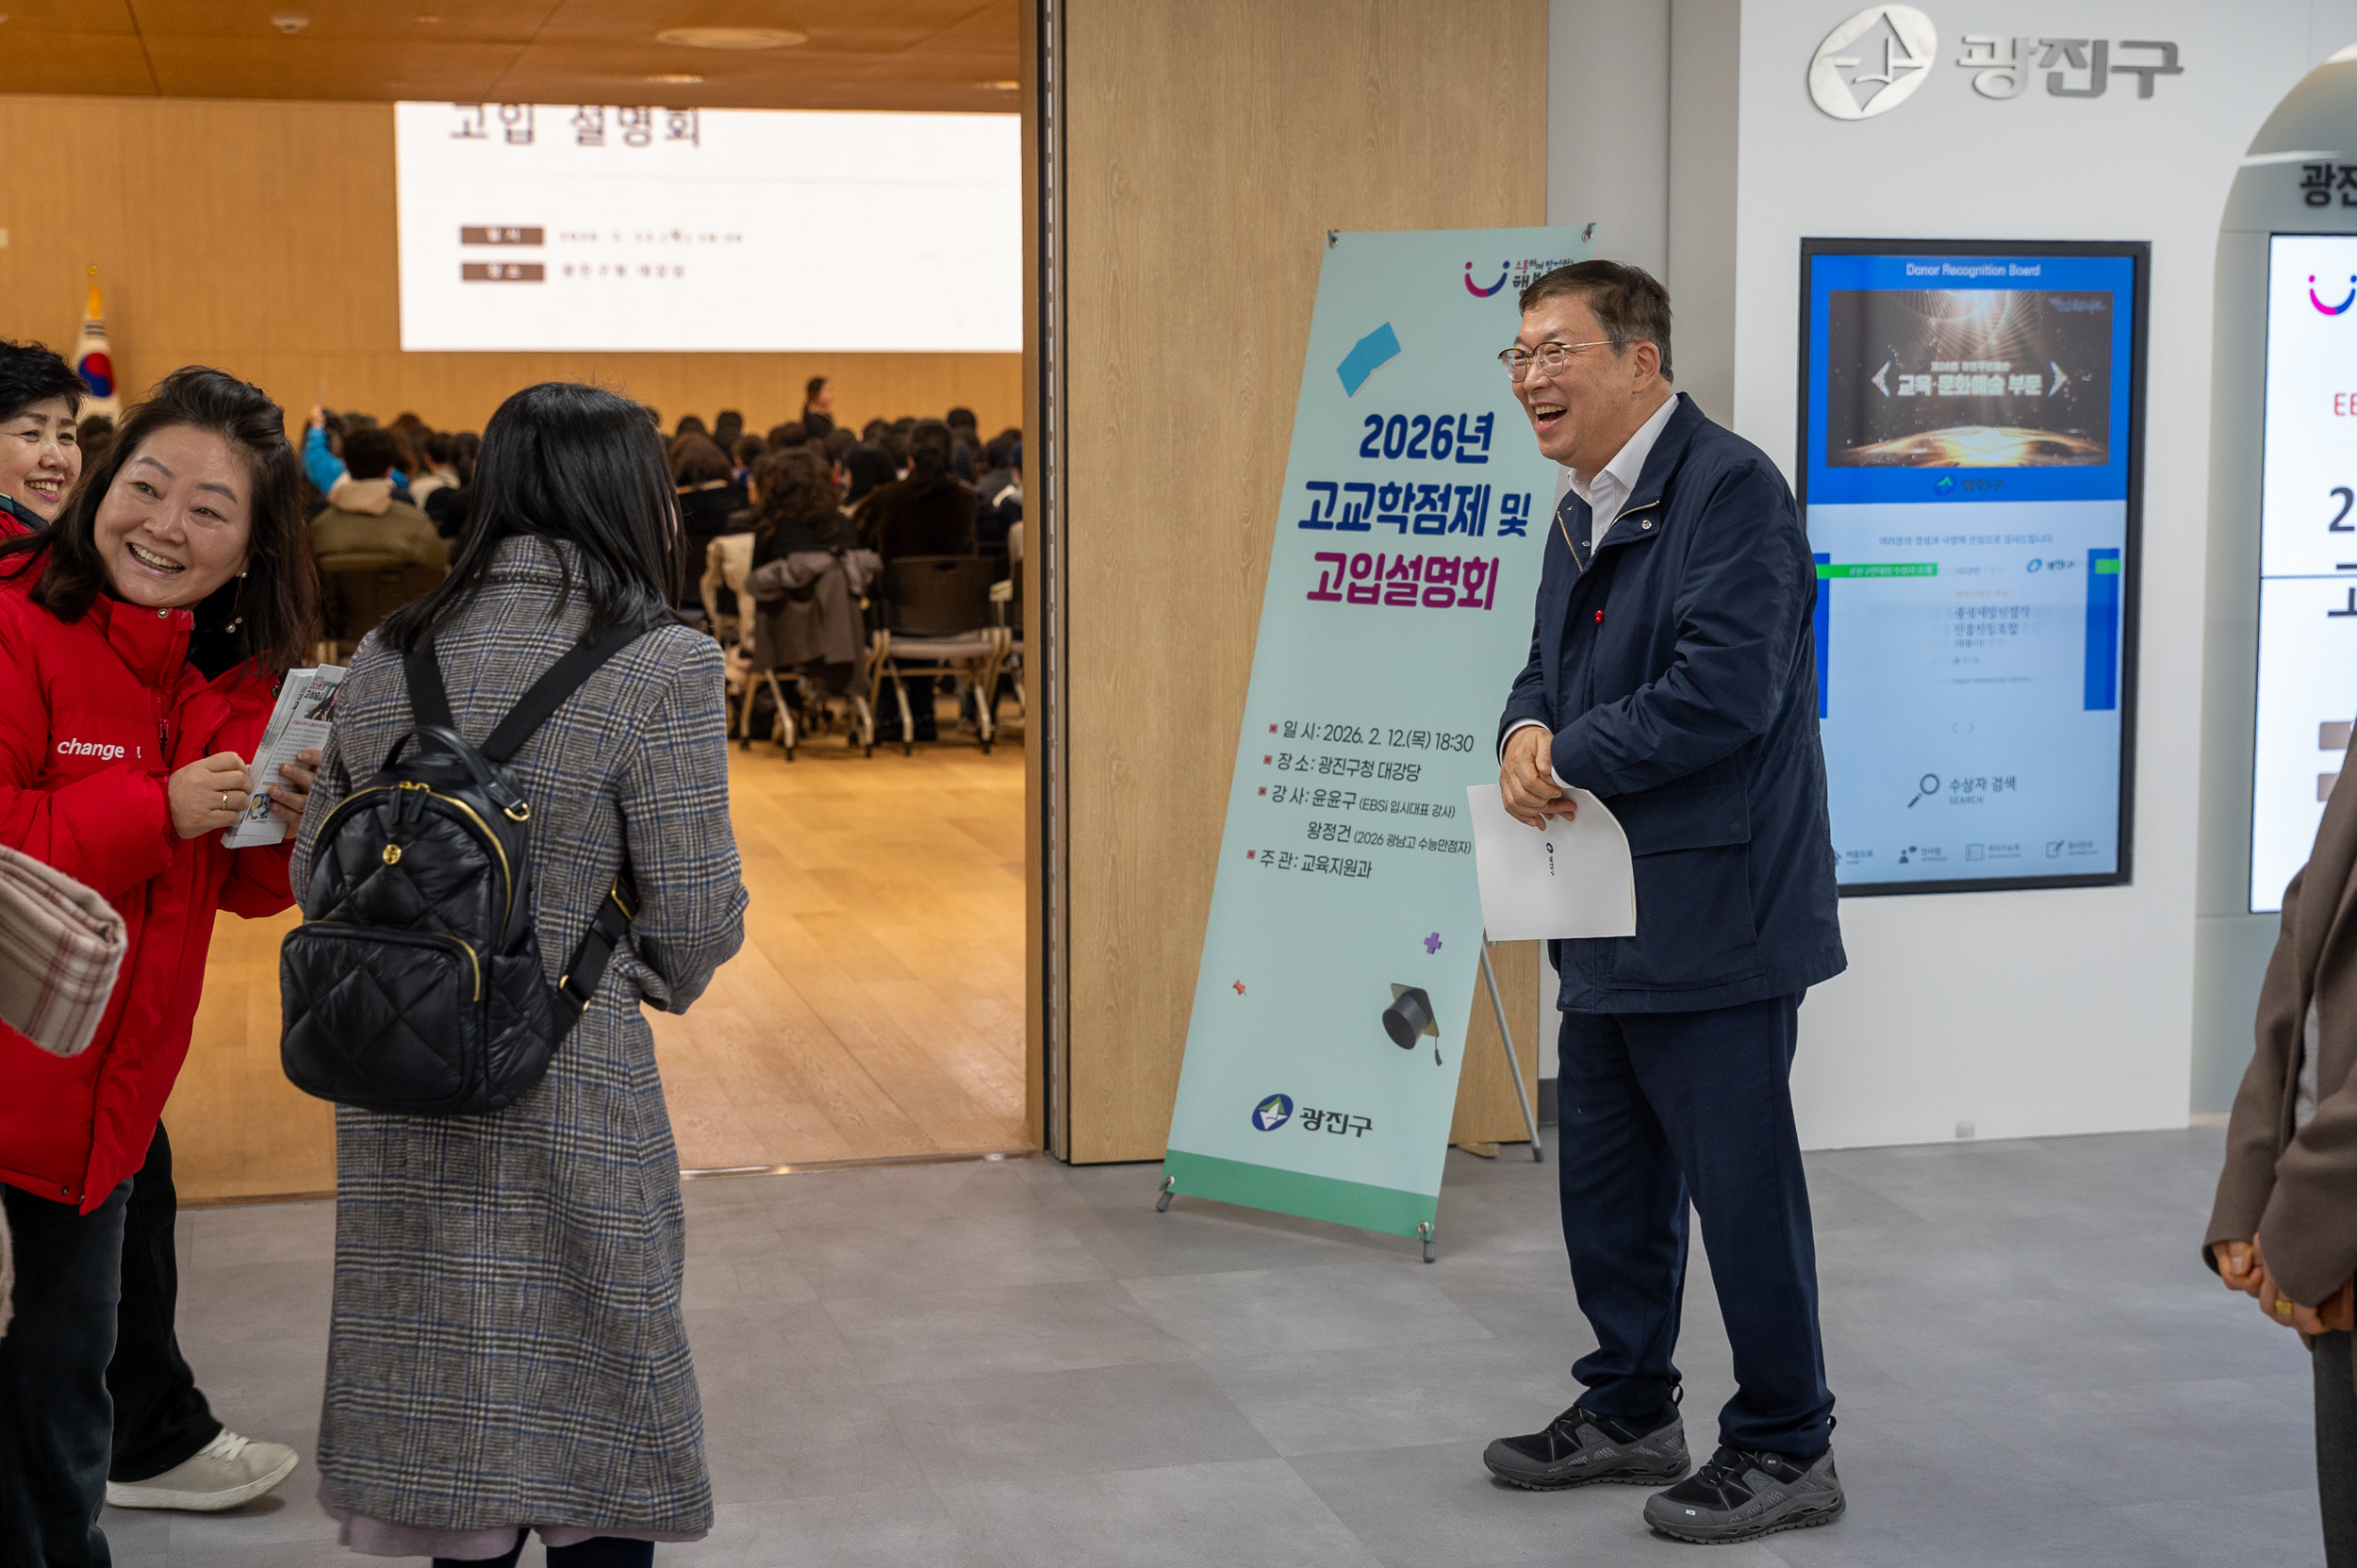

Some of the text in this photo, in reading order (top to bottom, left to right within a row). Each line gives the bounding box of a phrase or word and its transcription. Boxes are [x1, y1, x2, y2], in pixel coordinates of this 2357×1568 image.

[1956, 34, 2184, 99] 광진구
[1905, 262, 2041, 278] Donor Recognition Board
[2006, 373, 2043, 397] 부문
[1360, 412, 1494, 464] 2026년
[1297, 481, 1532, 537] 고교학점제 및
[1306, 552, 1500, 611] 고입설명회
[57, 737, 125, 761] change
[1435, 732, 1475, 752] 18:30
[1318, 755, 1374, 779] 광진구청
[1377, 762, 1422, 783] 대강당
[1311, 788, 1357, 810] 윤윤구
[1390, 801, 1429, 816] 입시대표
[1431, 803, 1456, 818] 강사)
[1307, 821, 1352, 843] 왕정건
[1354, 830, 1384, 846] (2026
[1386, 834, 1416, 850] 광남고
[1300, 854, 1373, 879] 교육지원과
[1299, 1107, 1374, 1138] 광진구
